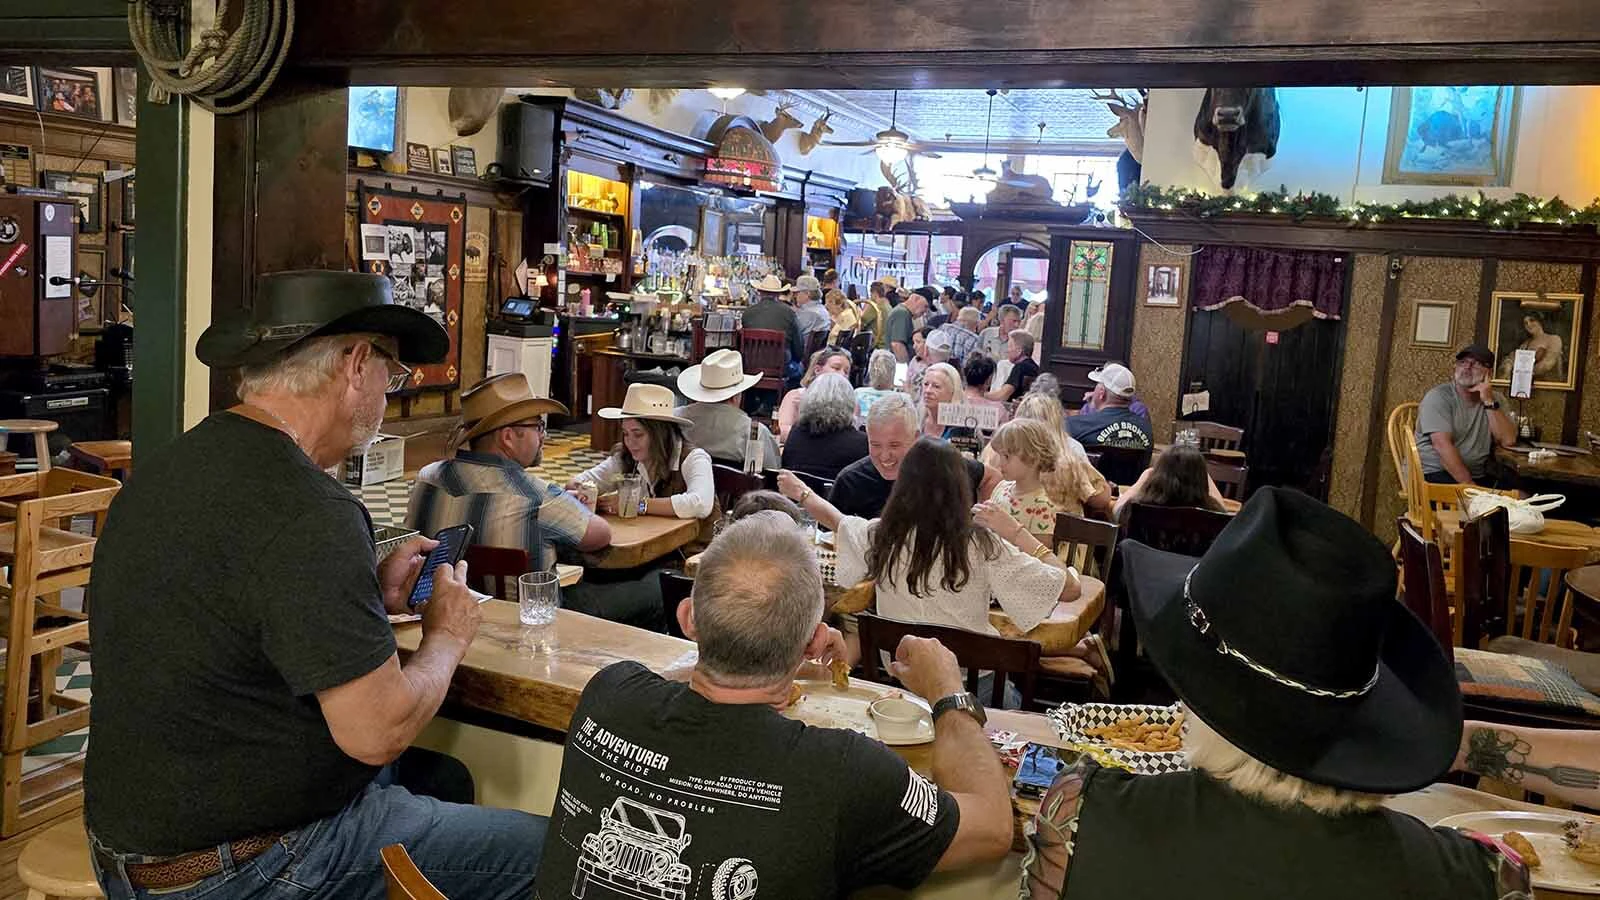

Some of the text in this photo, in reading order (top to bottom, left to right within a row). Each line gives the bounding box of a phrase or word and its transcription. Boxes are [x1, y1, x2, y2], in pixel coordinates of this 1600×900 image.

[1096, 422, 1120, 443] BEING
[1120, 421, 1150, 447] BROKEN
[575, 731, 650, 776] ENJOY THE RIDE
[580, 716, 670, 771] THE ADVENTURER
[599, 772, 611, 782] NO
[649, 792, 662, 801] NO
[667, 798, 715, 815] PROBLEM
[669, 777, 693, 788] MISSION:
[737, 791, 748, 799] DO
[748, 793, 781, 804] ANYTHING
[704, 779, 732, 789] OFF-ROAD
[733, 784, 756, 793] UTILITY
[756, 788, 782, 798] VEHICLE
[728, 777, 756, 786] PRODUCT
